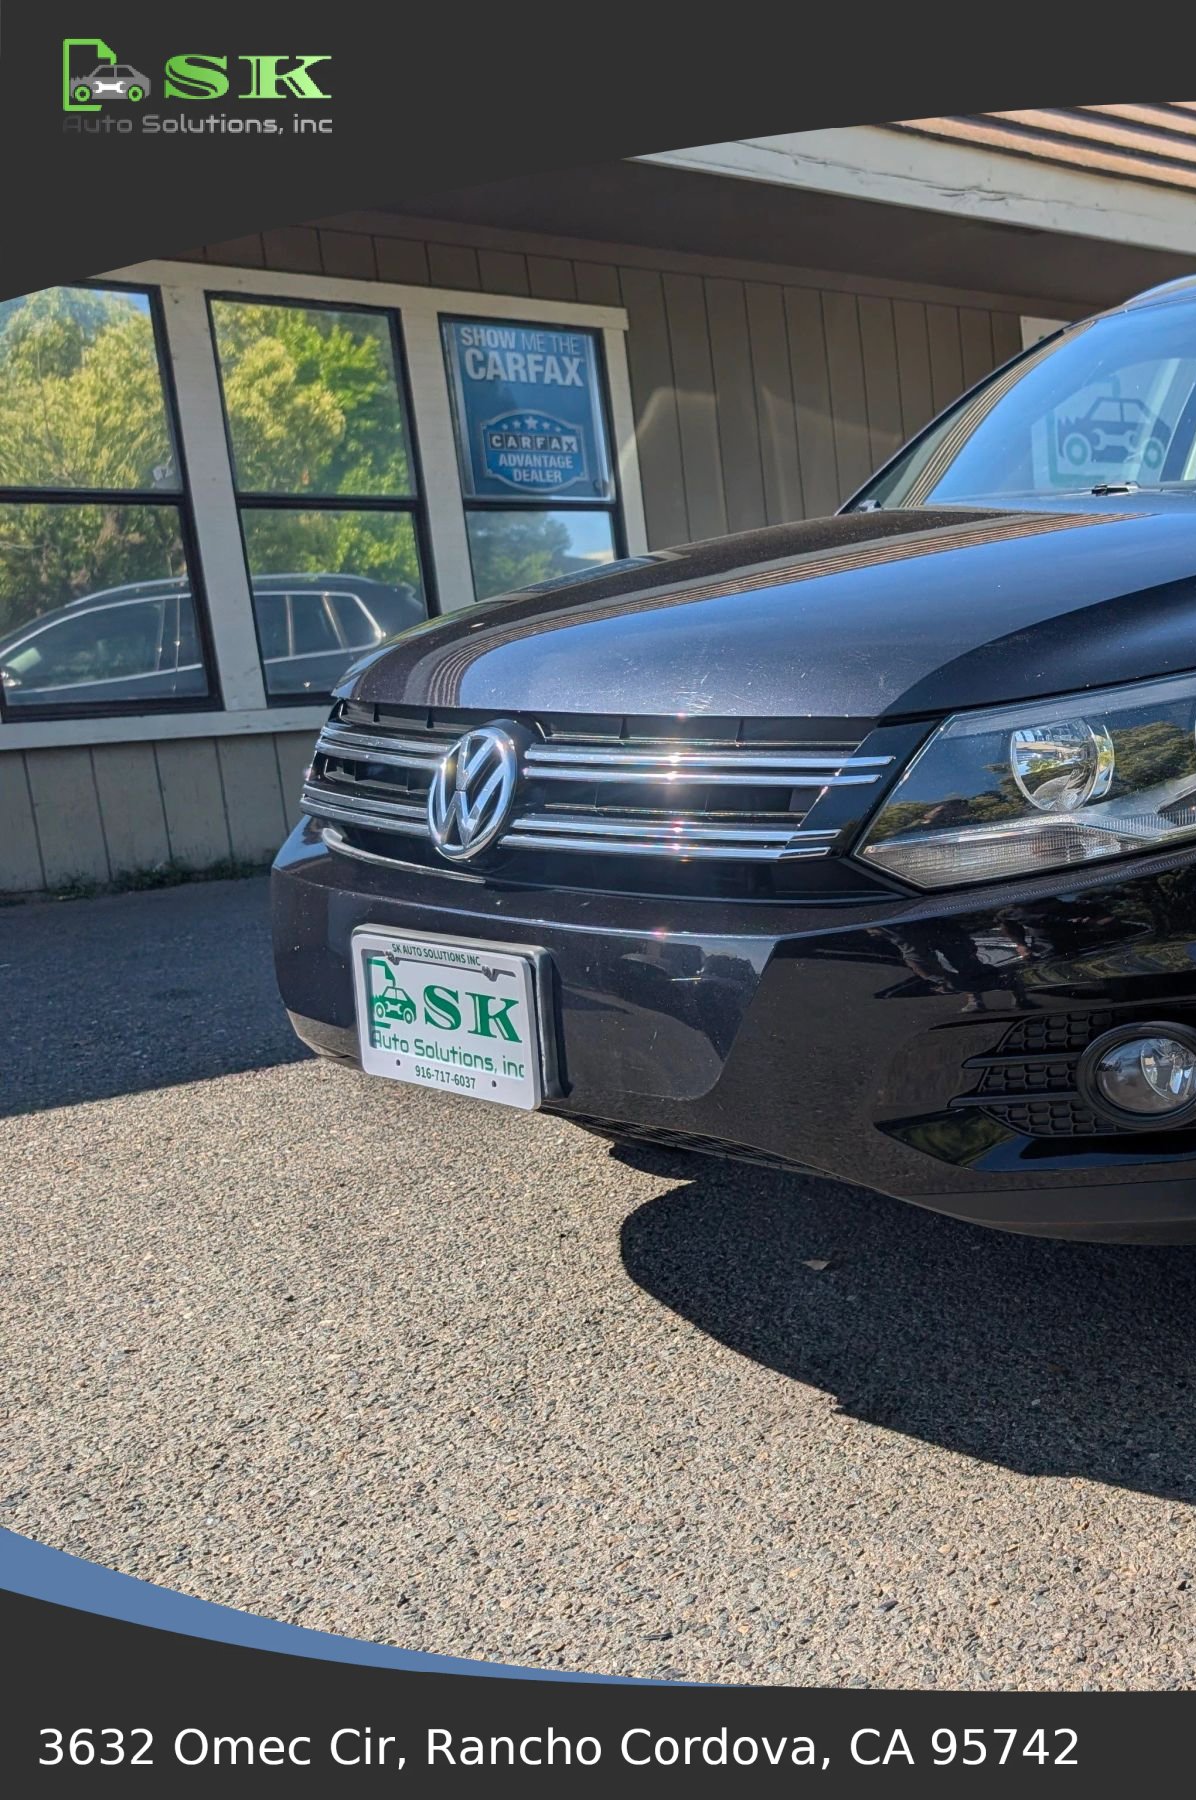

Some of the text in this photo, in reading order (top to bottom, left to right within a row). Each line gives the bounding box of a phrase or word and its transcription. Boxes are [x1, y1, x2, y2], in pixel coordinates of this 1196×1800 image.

[461, 327, 581, 355] SHOW ME THE
[465, 347, 584, 387] CARFAX
[490, 435, 577, 453] CARFAX
[499, 453, 574, 469] ADVANTAGE
[513, 468, 562, 483] DEALER
[391, 943, 481, 966] SK AUTO SOLUTIONS INC
[423, 984, 523, 1043] SK
[371, 1030, 525, 1079] Auto Solutions, inc
[415, 1065, 476, 1089] 916-717-6037
